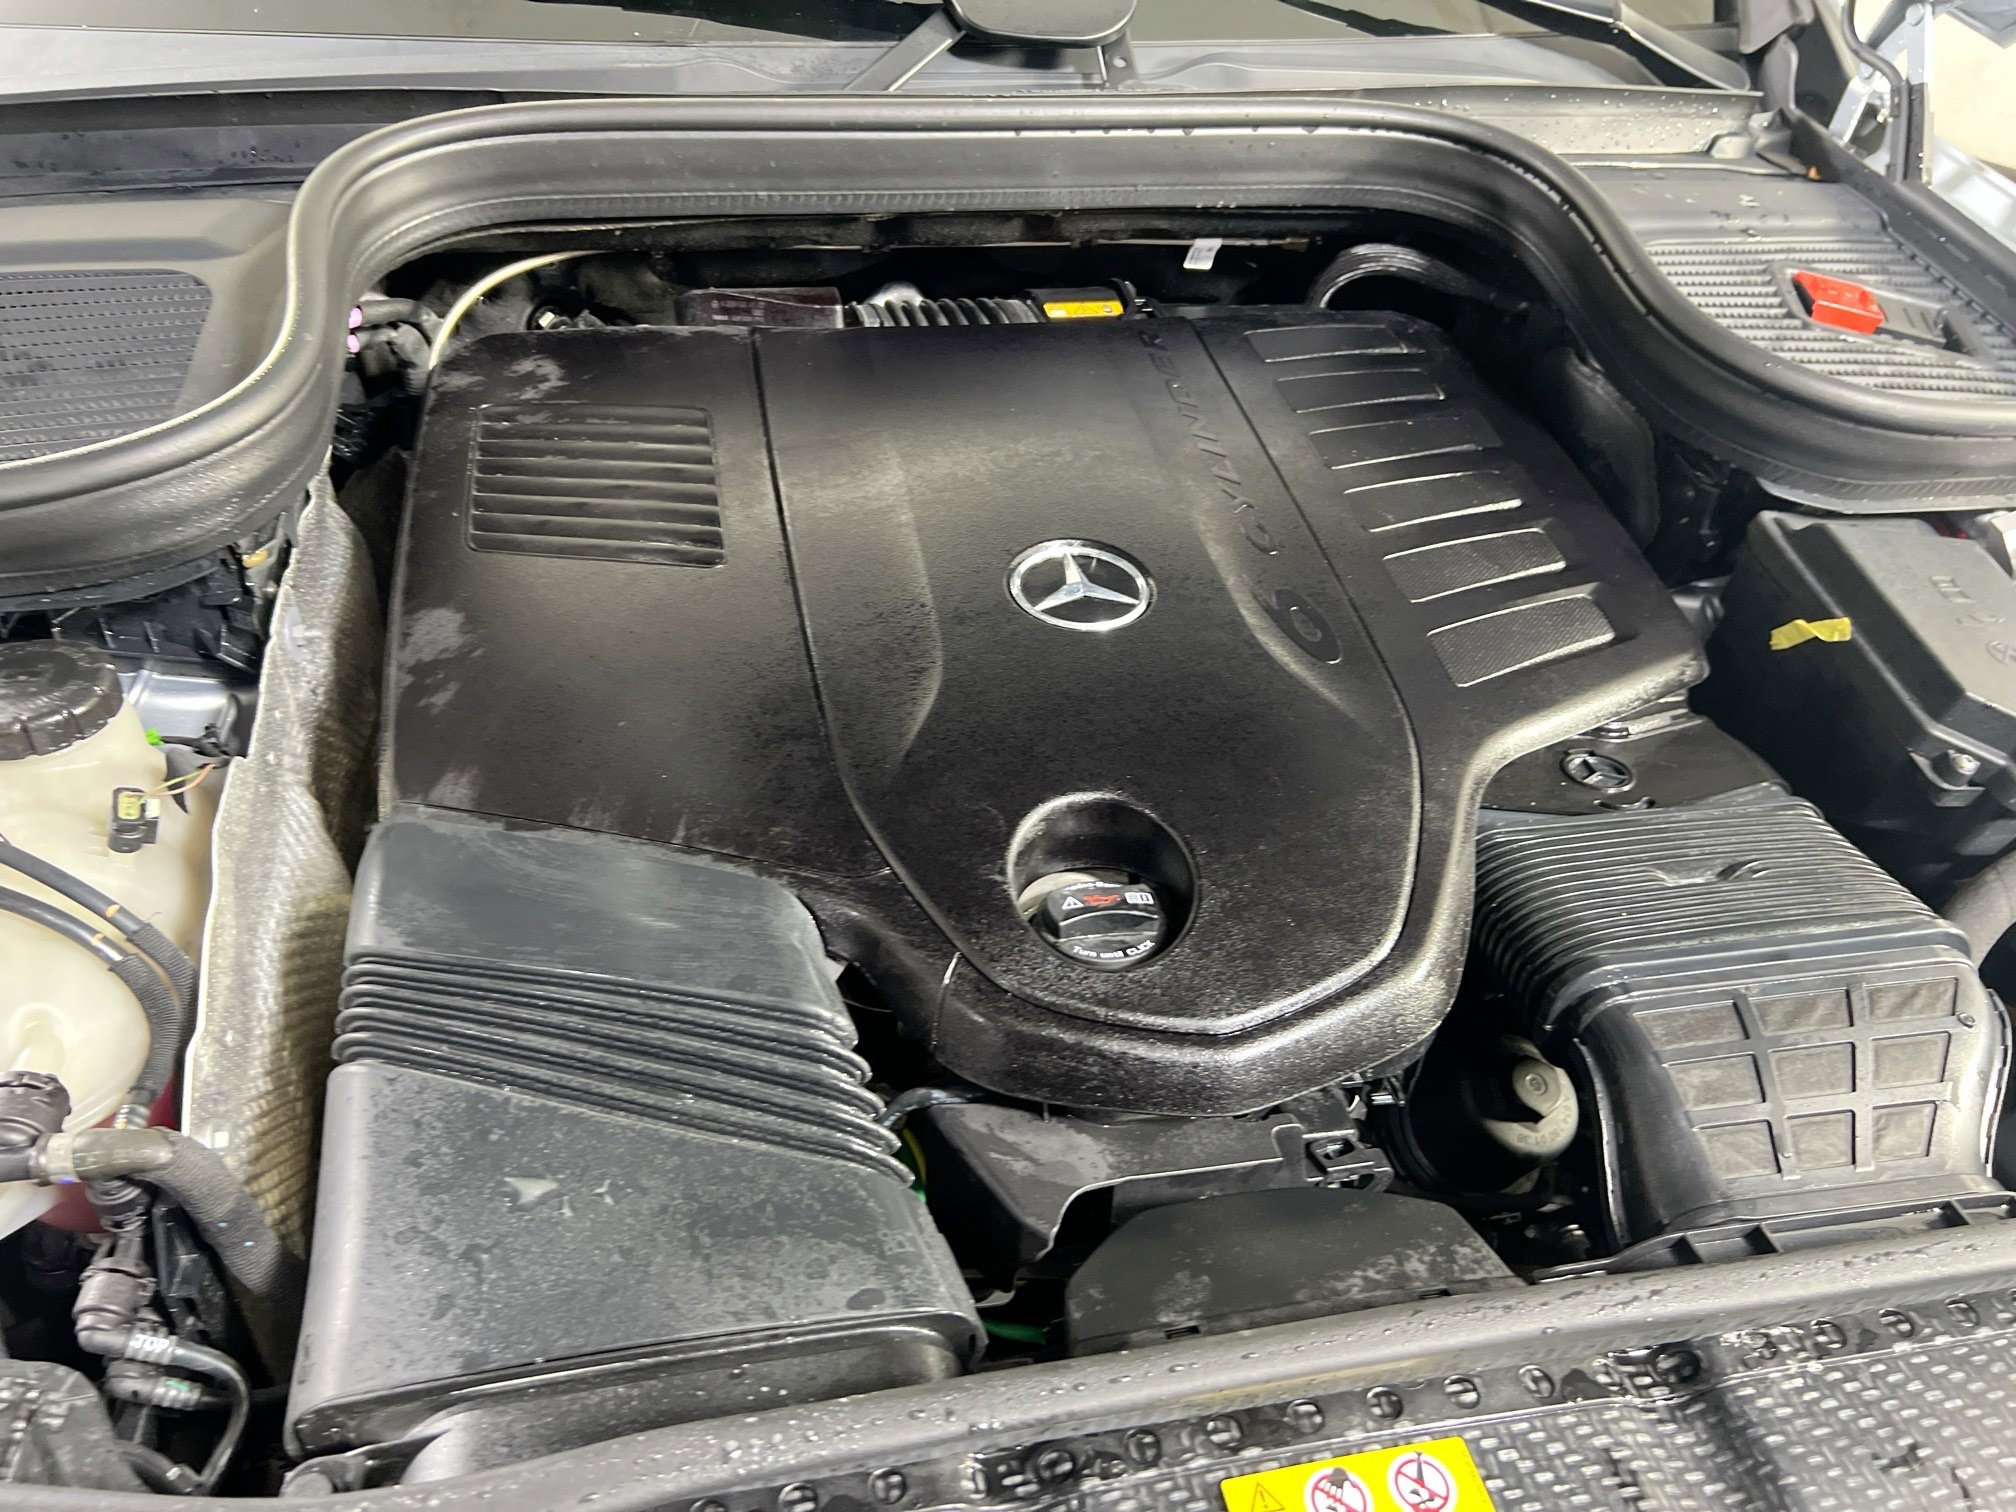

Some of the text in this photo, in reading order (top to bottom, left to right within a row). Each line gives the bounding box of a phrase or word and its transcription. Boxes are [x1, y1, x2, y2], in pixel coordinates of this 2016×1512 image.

[1138, 328, 1280, 556] CYLINDER
[1073, 939, 1156, 959] Turn until CLICK
